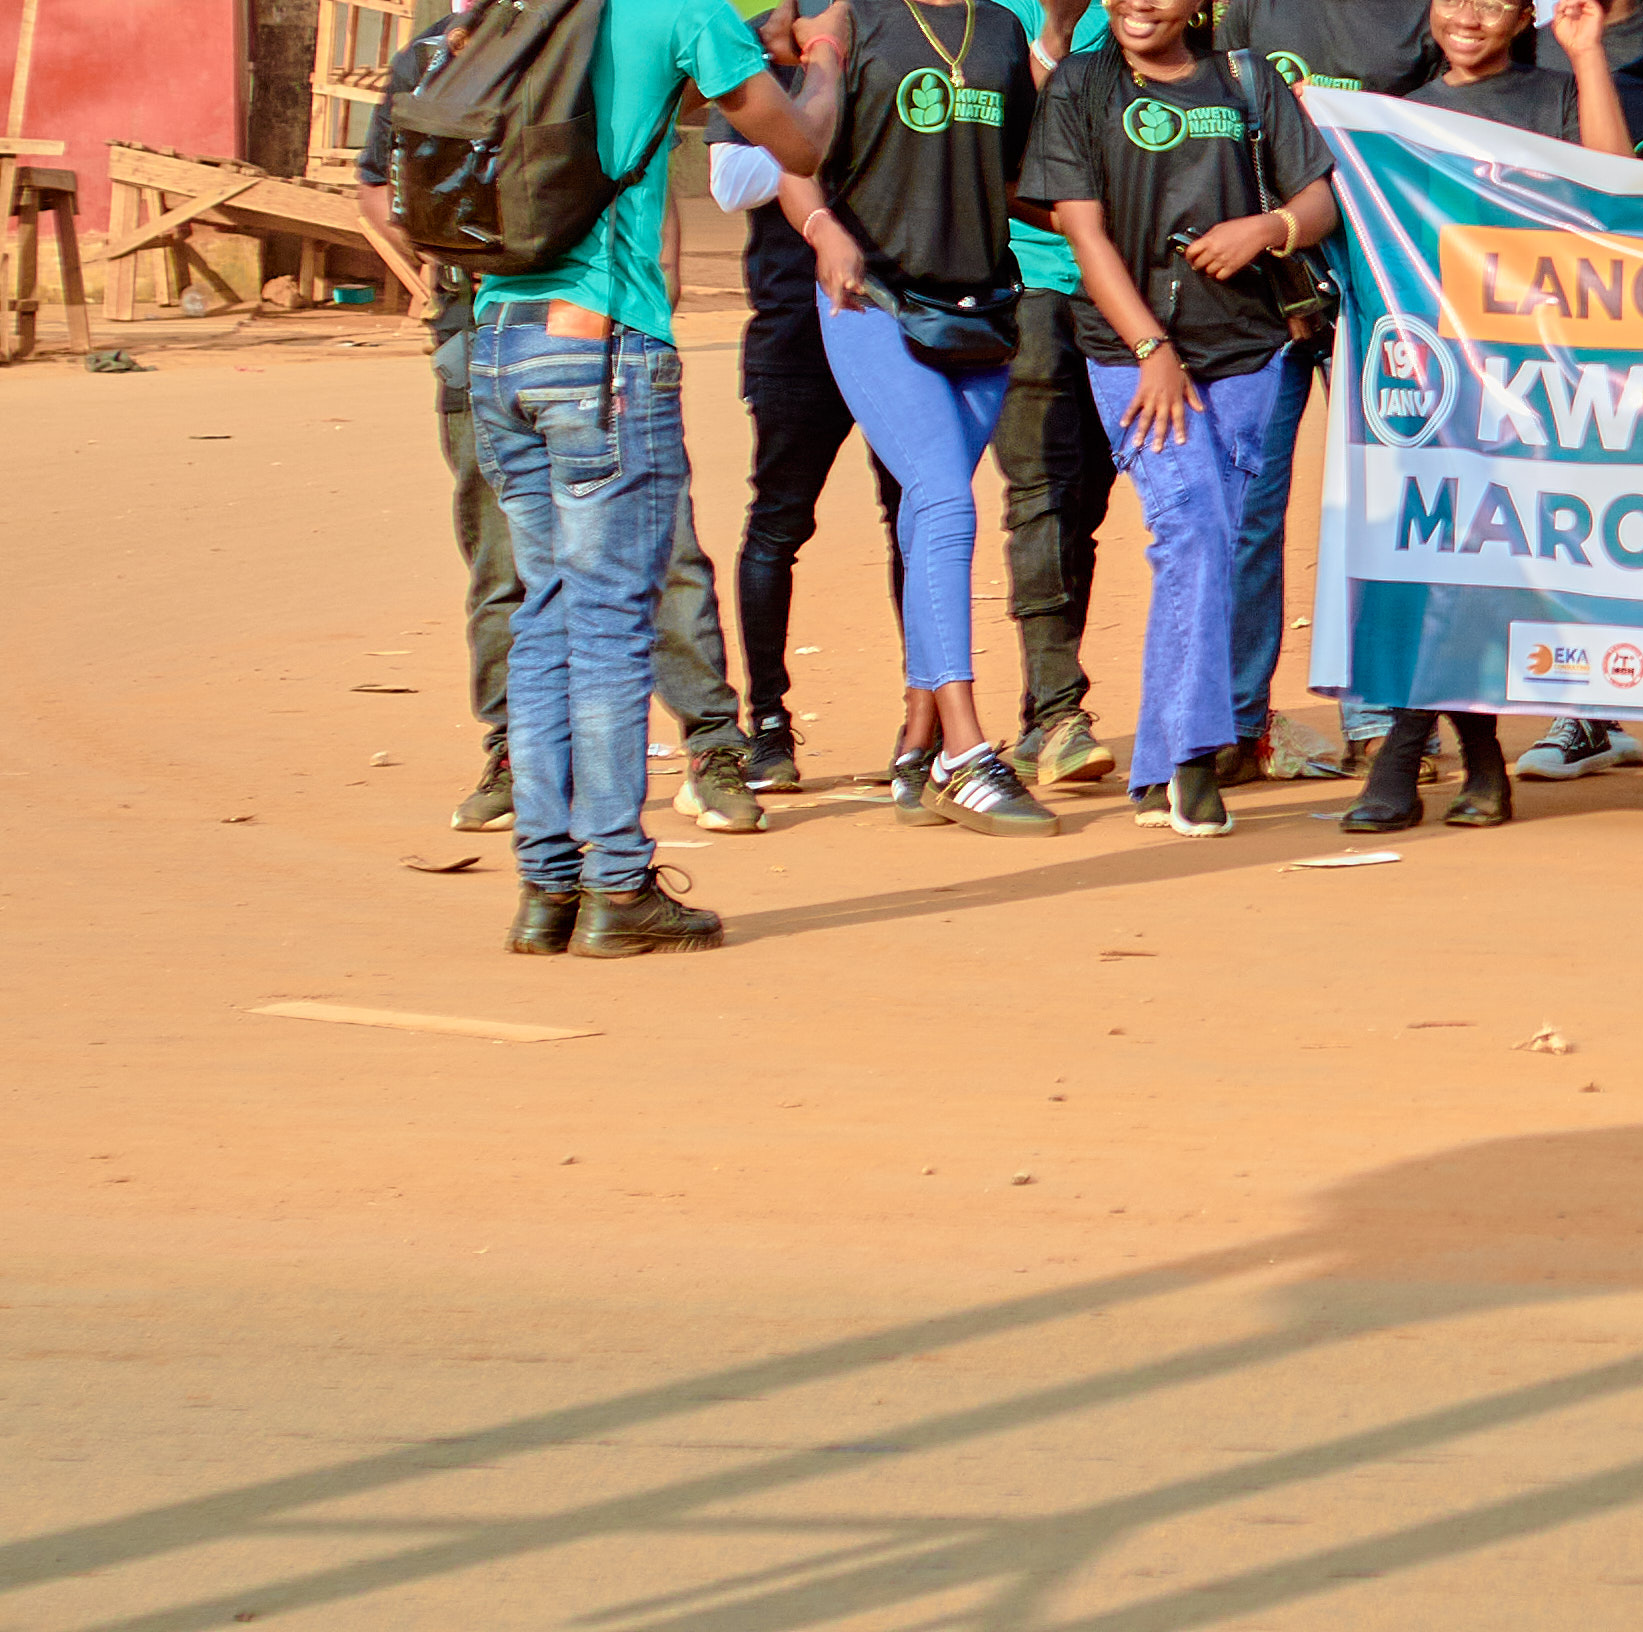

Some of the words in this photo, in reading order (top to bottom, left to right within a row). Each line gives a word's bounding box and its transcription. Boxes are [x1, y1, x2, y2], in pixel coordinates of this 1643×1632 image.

[1384, 340, 1419, 379] 19
[1379, 388, 1435, 418] JANV
[1554, 647, 1589, 664] EKA
